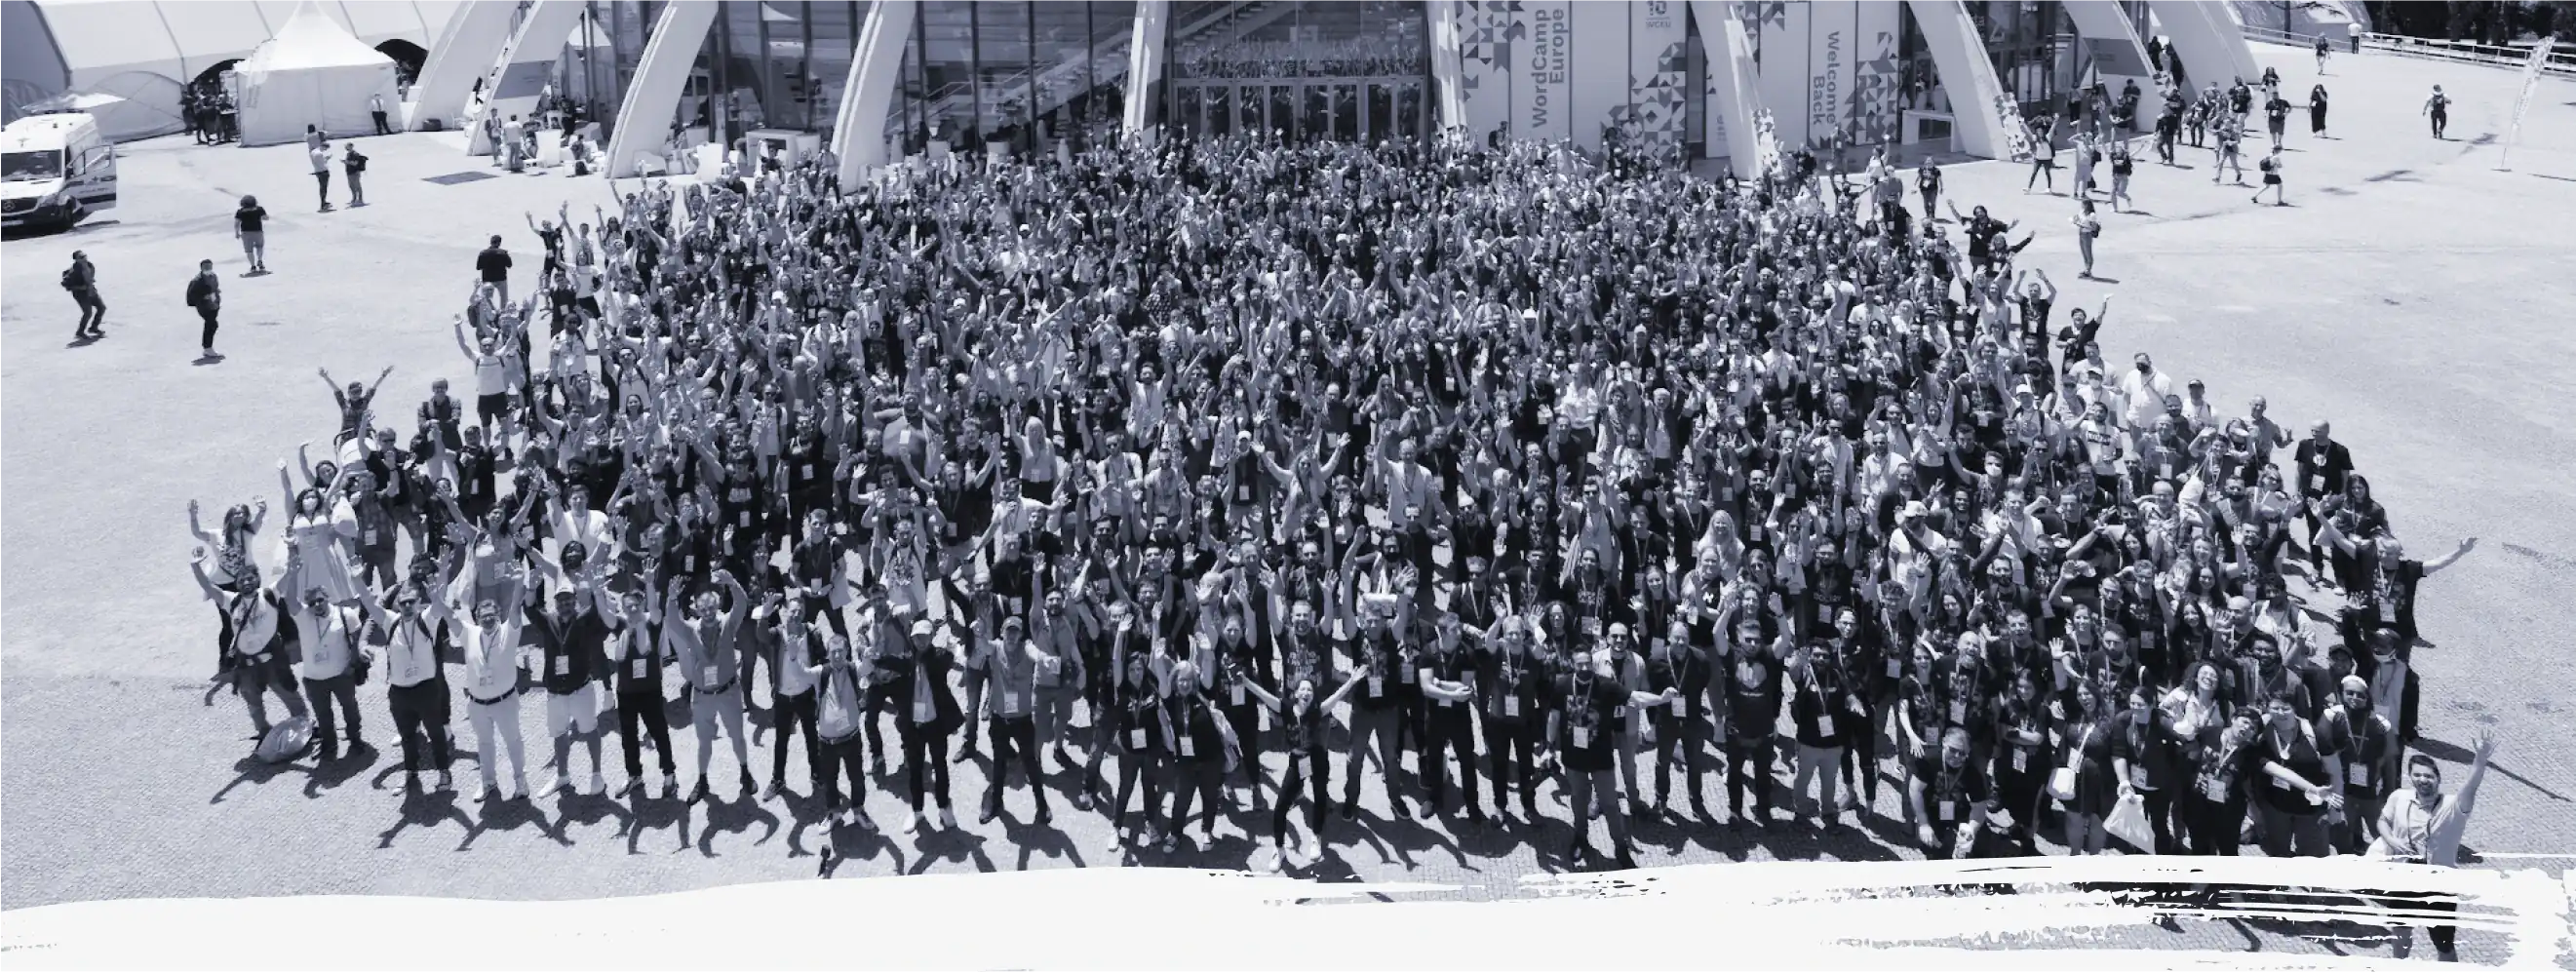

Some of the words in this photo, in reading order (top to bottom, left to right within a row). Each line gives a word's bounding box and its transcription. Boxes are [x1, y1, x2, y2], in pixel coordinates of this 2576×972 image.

[1531, 9, 1551, 128] WordCamp
[1548, 8, 1568, 84] Europe
[1826, 30, 1840, 124] Welcome
[1814, 76, 1826, 125] Back
